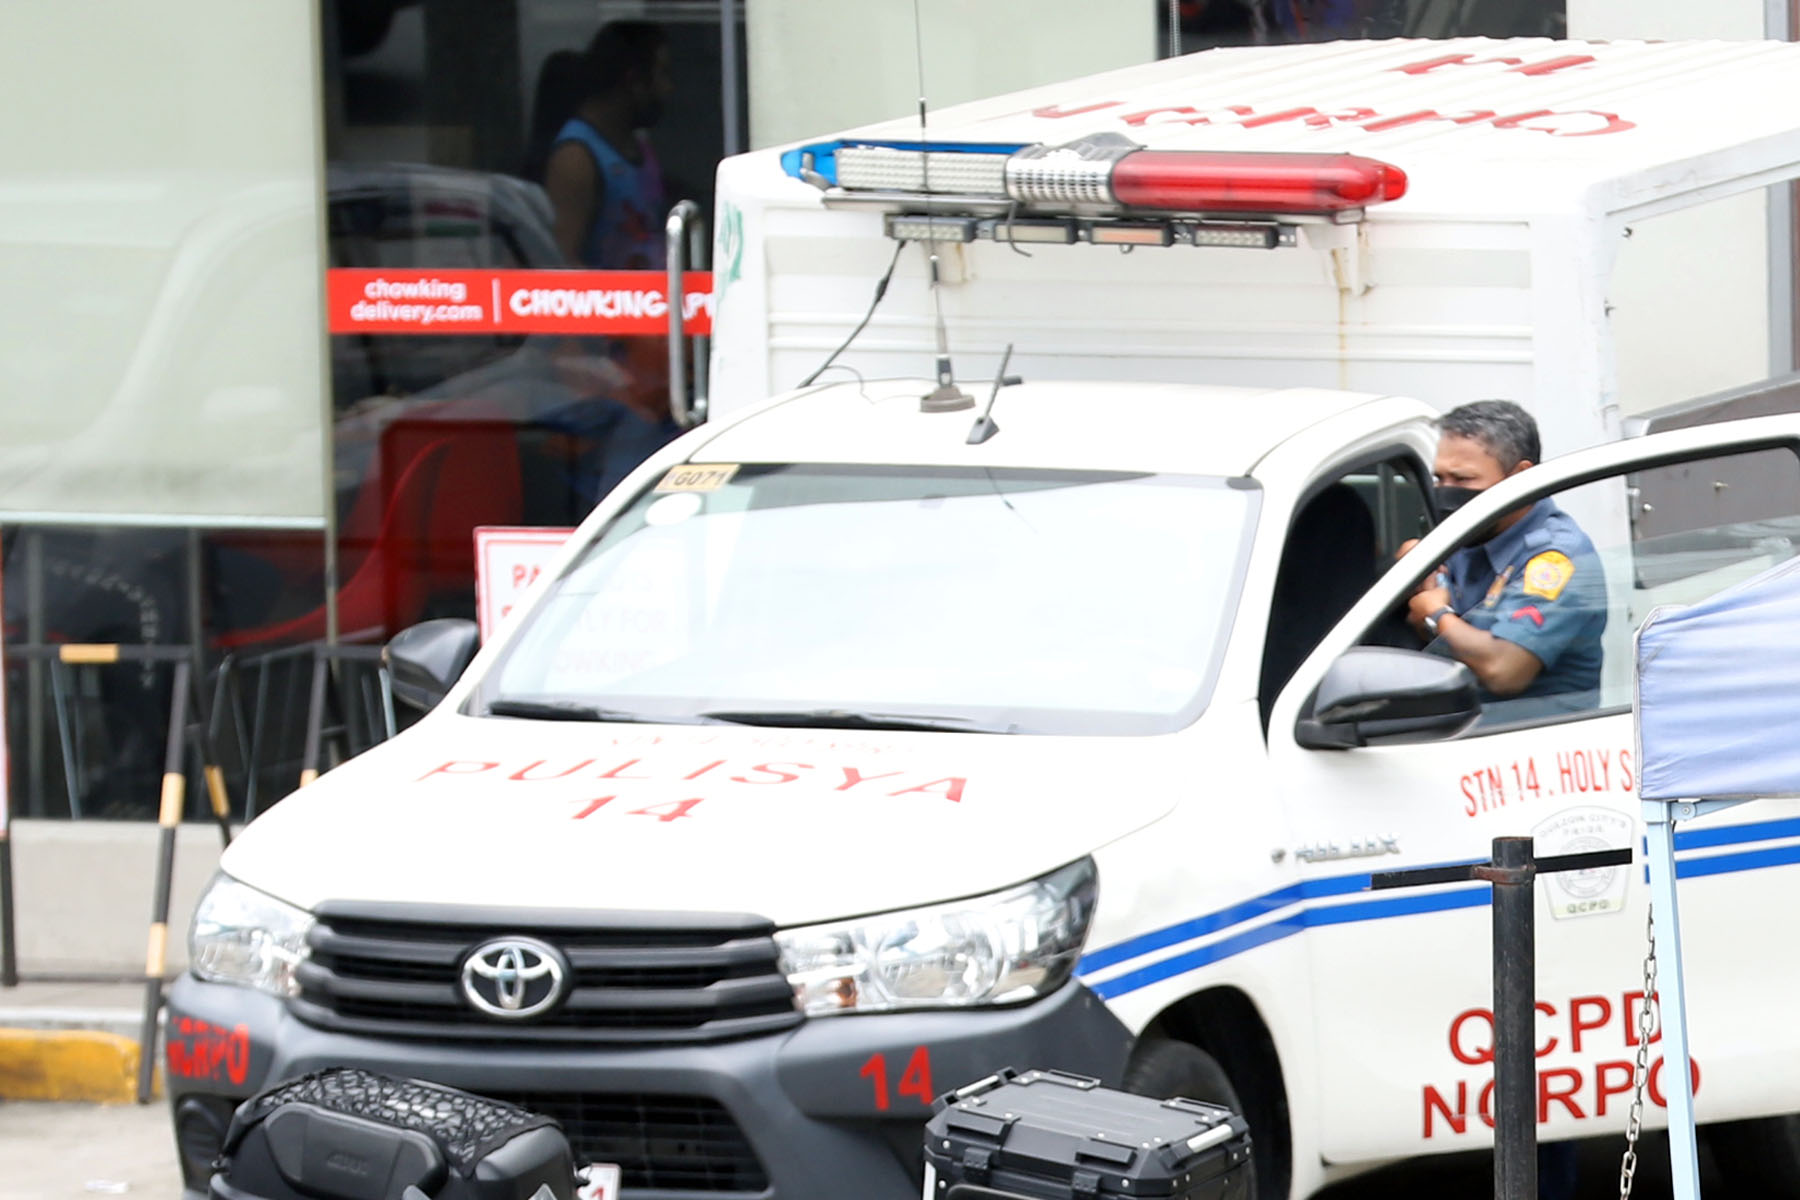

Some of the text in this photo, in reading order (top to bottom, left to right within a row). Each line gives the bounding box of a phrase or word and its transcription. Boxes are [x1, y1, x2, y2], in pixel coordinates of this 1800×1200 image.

[364, 279, 467, 302] chowking
[509, 289, 668, 318] CHOWKING
[350, 302, 483, 324] delivery.com
[413, 758, 967, 803] PULISYA
[1460, 764, 1507, 818] STN
[1557, 748, 1610, 795] HOLY
[1619, 749, 1633, 792] S
[568, 795, 705, 823] 14
[860, 1045, 936, 1111] 14
